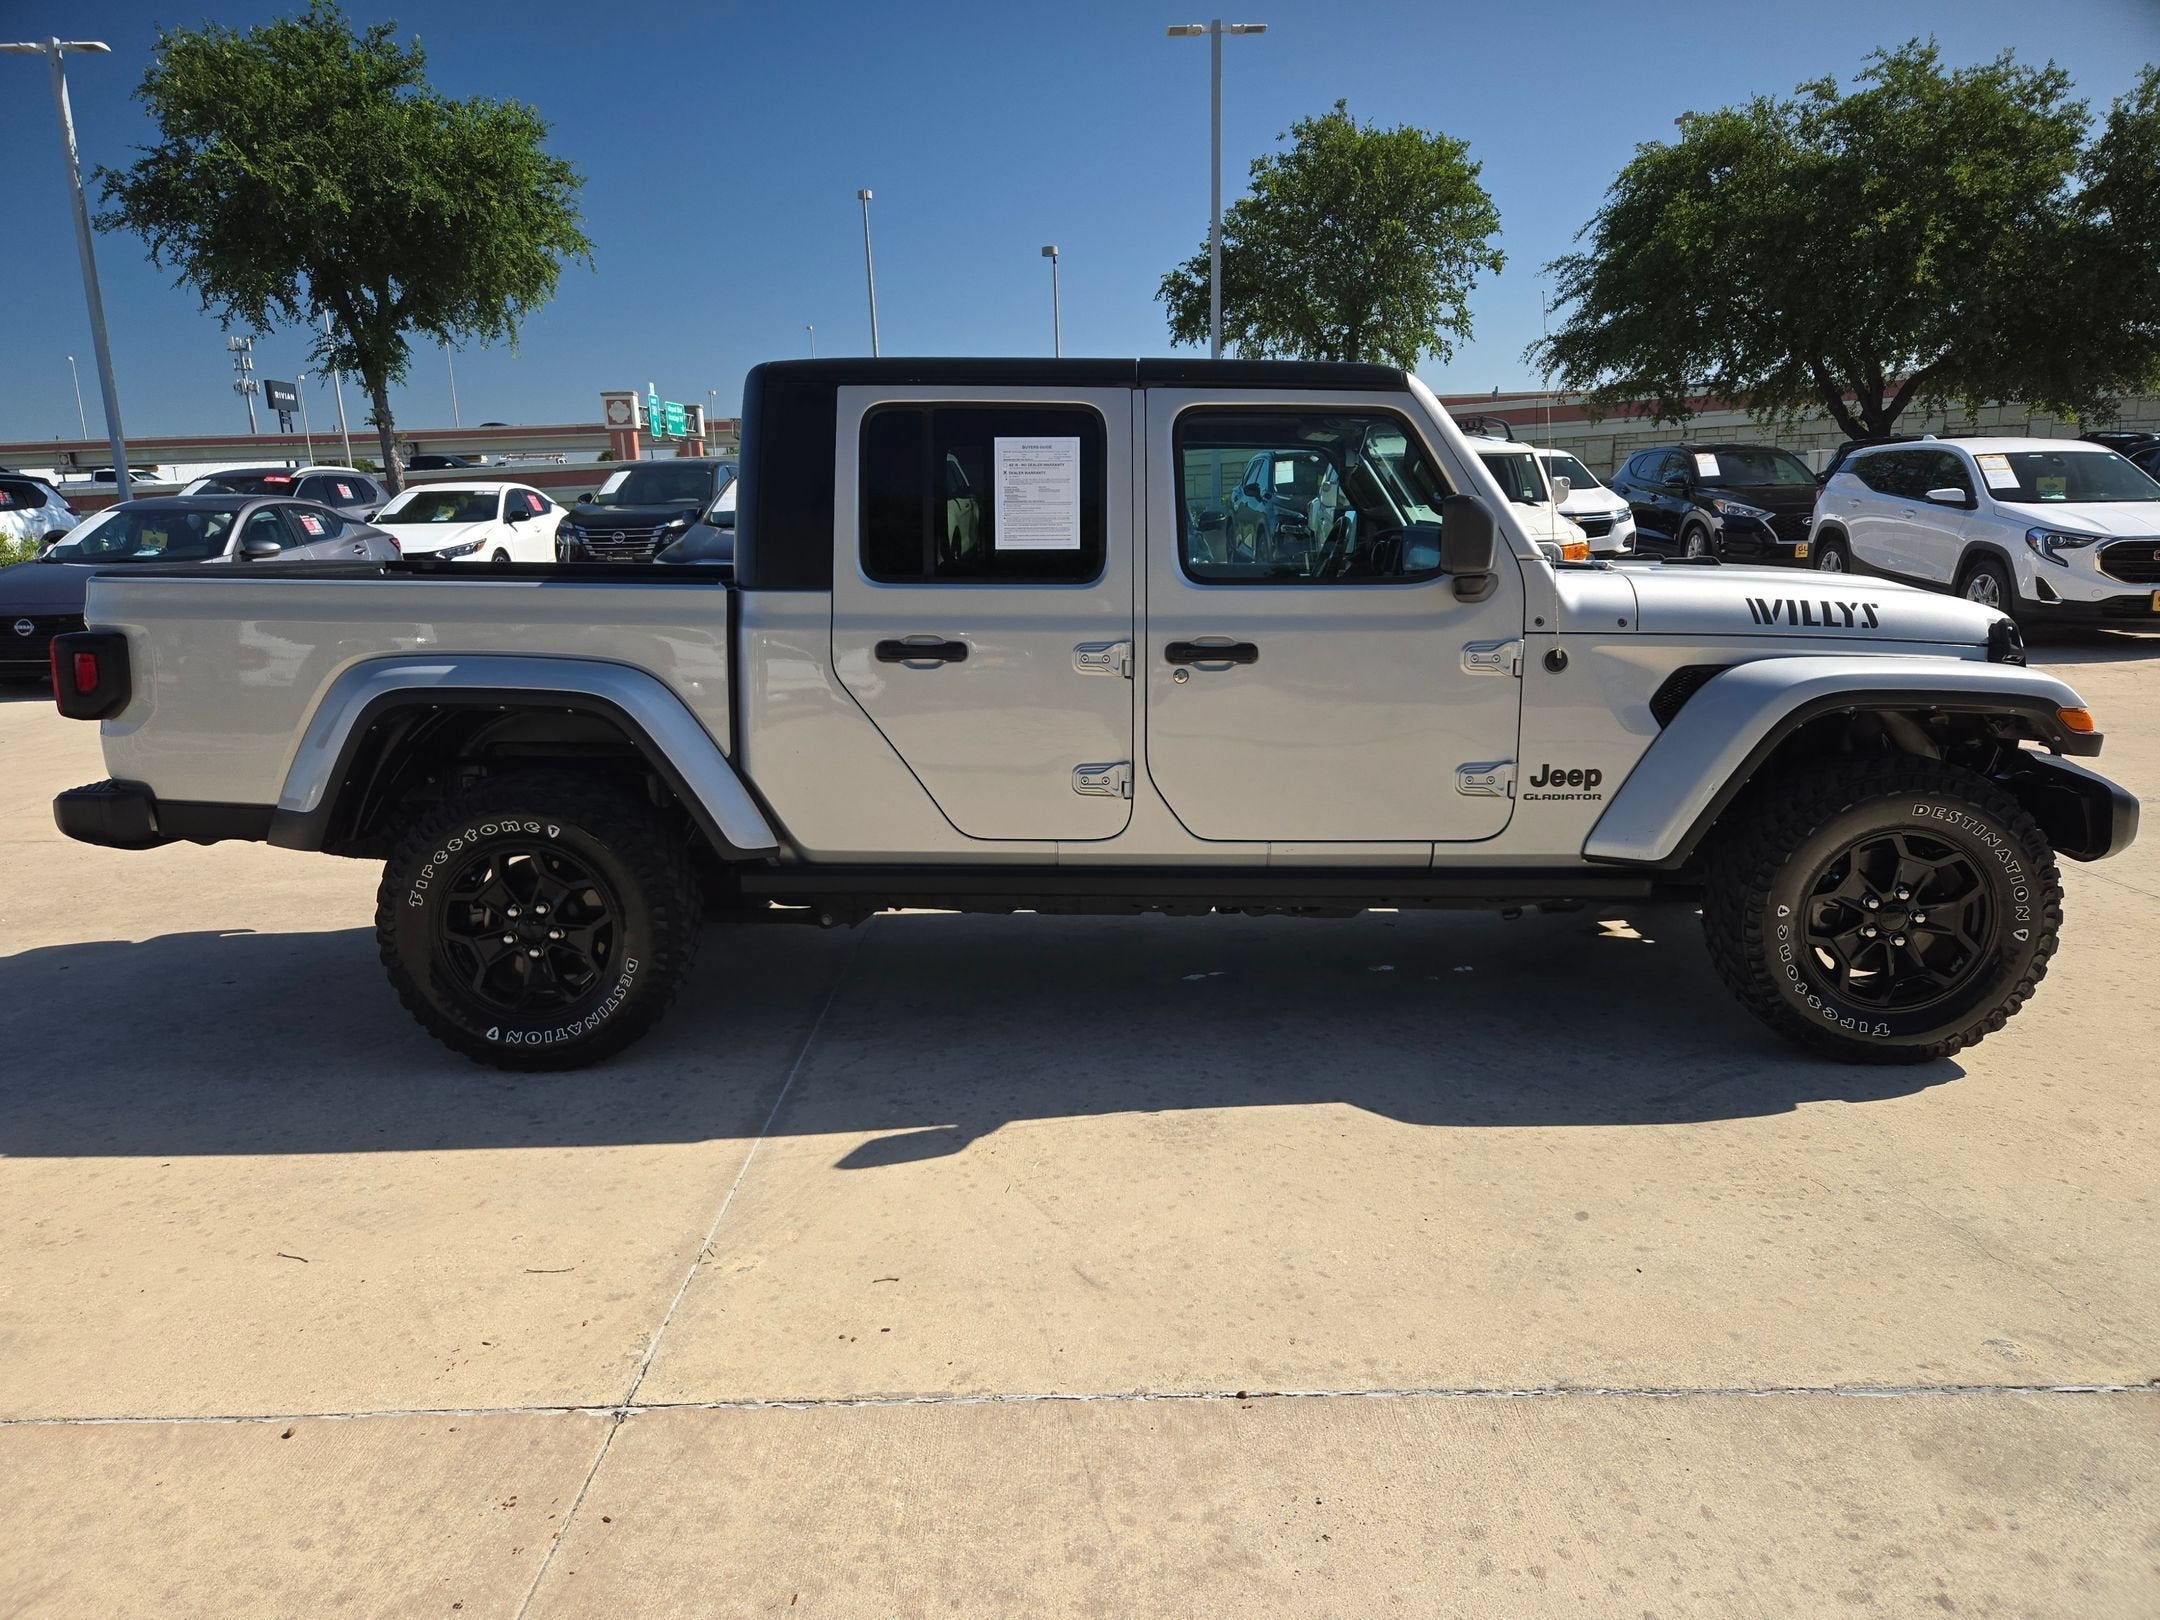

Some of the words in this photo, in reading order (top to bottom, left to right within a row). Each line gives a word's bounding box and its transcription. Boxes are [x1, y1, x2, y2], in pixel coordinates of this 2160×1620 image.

[274, 391, 295, 401] RIVIAN
[1745, 597, 1879, 629] WILLYS
[1530, 763, 1602, 791] Jeep
[409, 820, 541, 907] Firestone
[1912, 803, 2030, 921] DESTINATION
[506, 957, 639, 1045] DESTINATION
[1777, 924, 1890, 1037] Firestone
